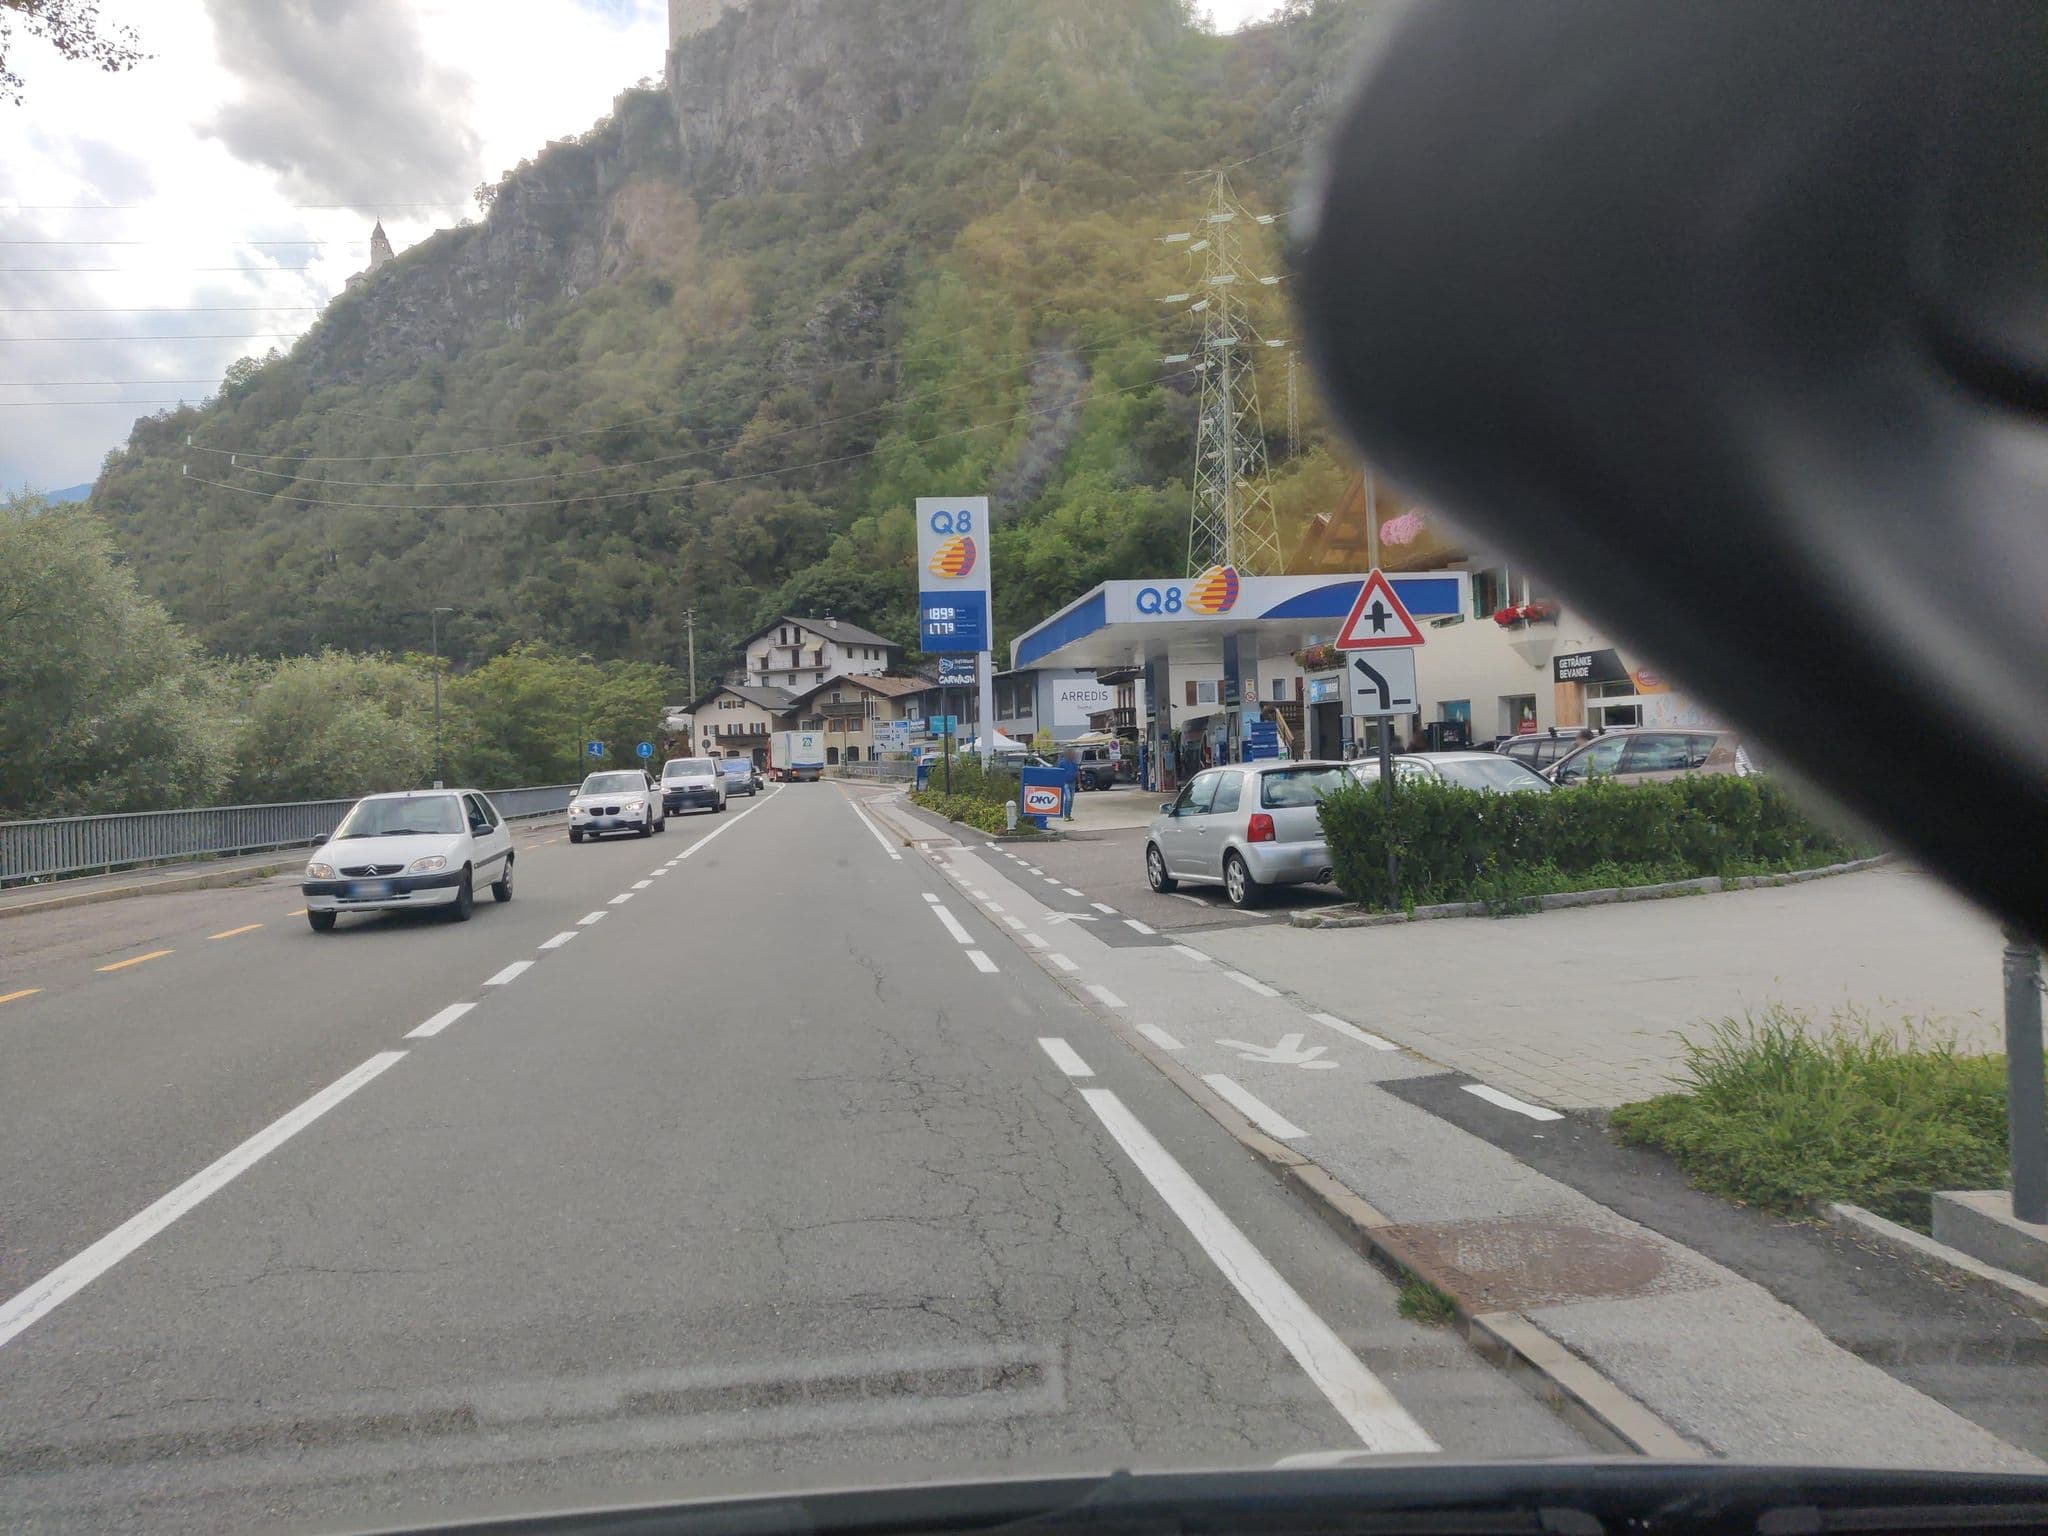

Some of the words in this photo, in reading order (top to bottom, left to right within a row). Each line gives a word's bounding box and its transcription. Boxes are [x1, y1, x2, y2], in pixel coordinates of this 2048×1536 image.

[930, 510, 972, 534] Q8
[1136, 587, 1182, 614] Q8
[1559, 655, 1592, 669] GETRÄNKE
[1560, 667, 1589, 679] BEVANDE
[938, 674, 976, 685] CARWASH
[1061, 690, 1109, 702] ARREDIS
[1029, 795, 1056, 805] DKV
